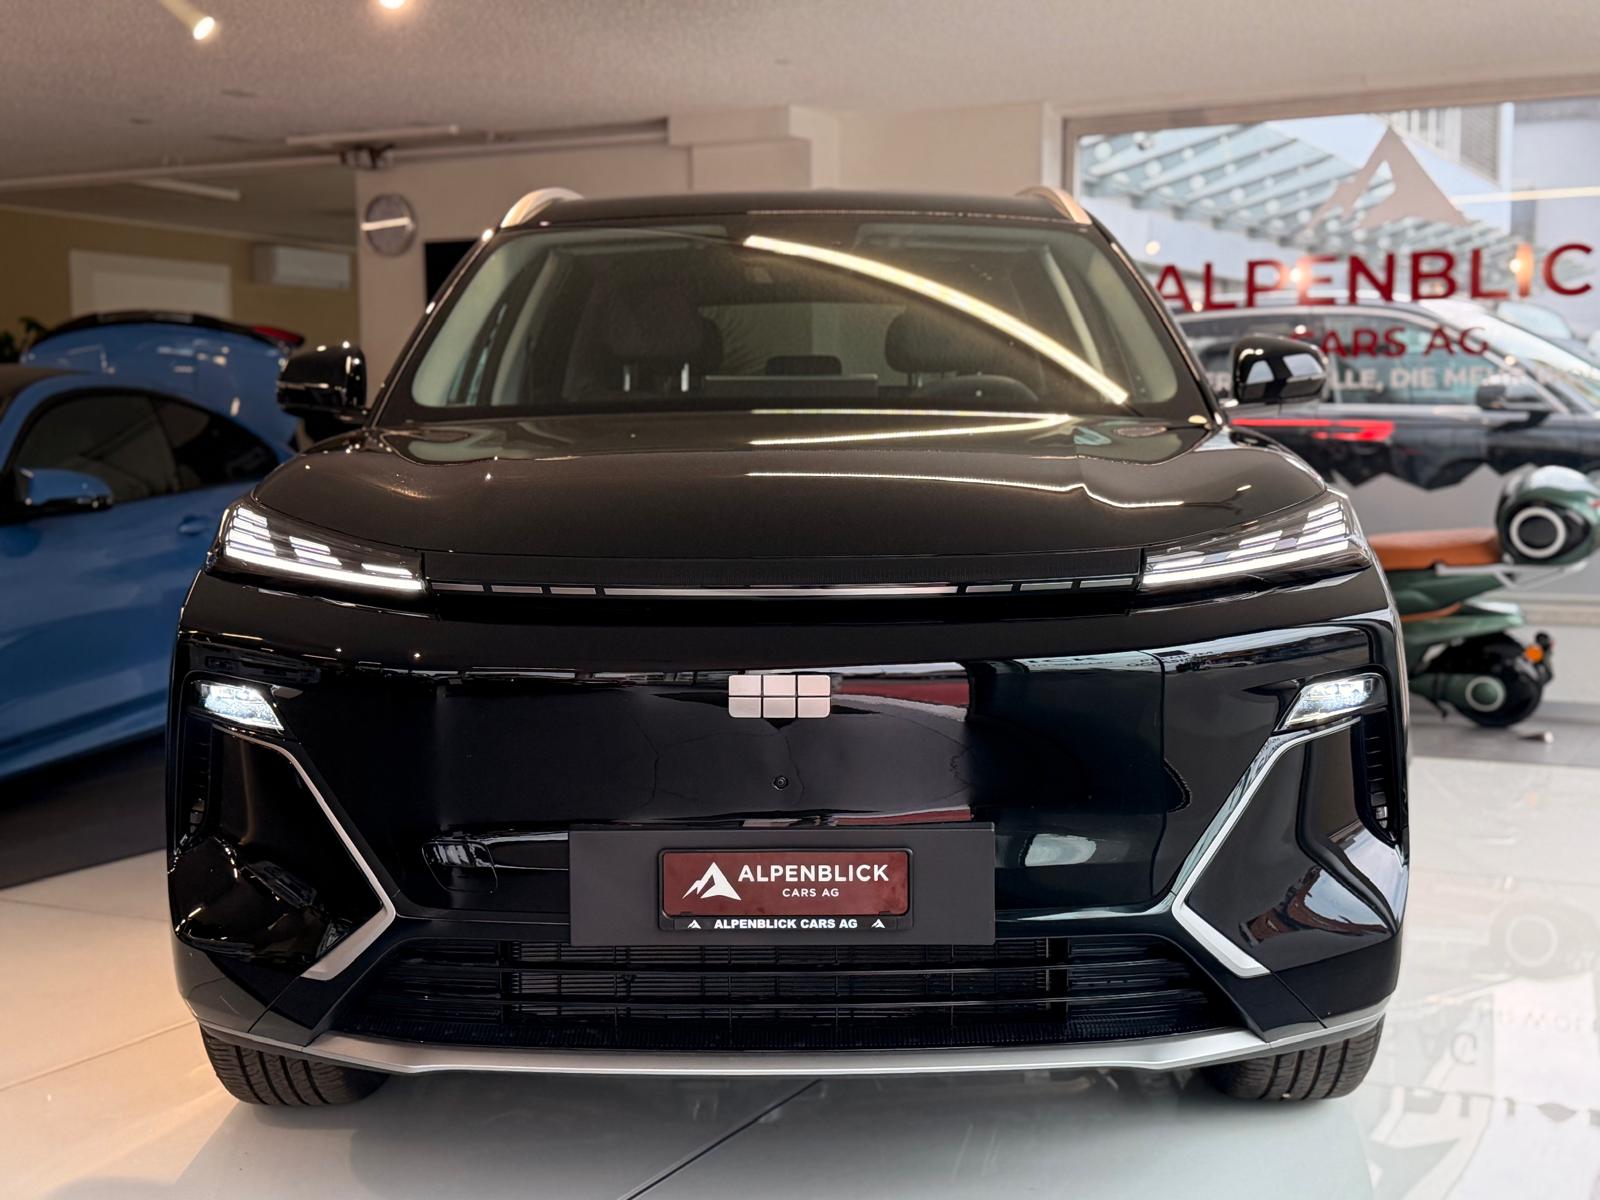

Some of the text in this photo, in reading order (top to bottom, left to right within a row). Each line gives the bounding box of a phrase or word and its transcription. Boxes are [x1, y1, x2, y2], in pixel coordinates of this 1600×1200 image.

[1290, 326, 1489, 359] ARS AG
[1390, 366, 1437, 389] DIE
[738, 864, 889, 882] ALPENBLICK
[782, 888, 840, 897] CARS AG
[713, 919, 858, 929] ALPENBLICK CARS AG
